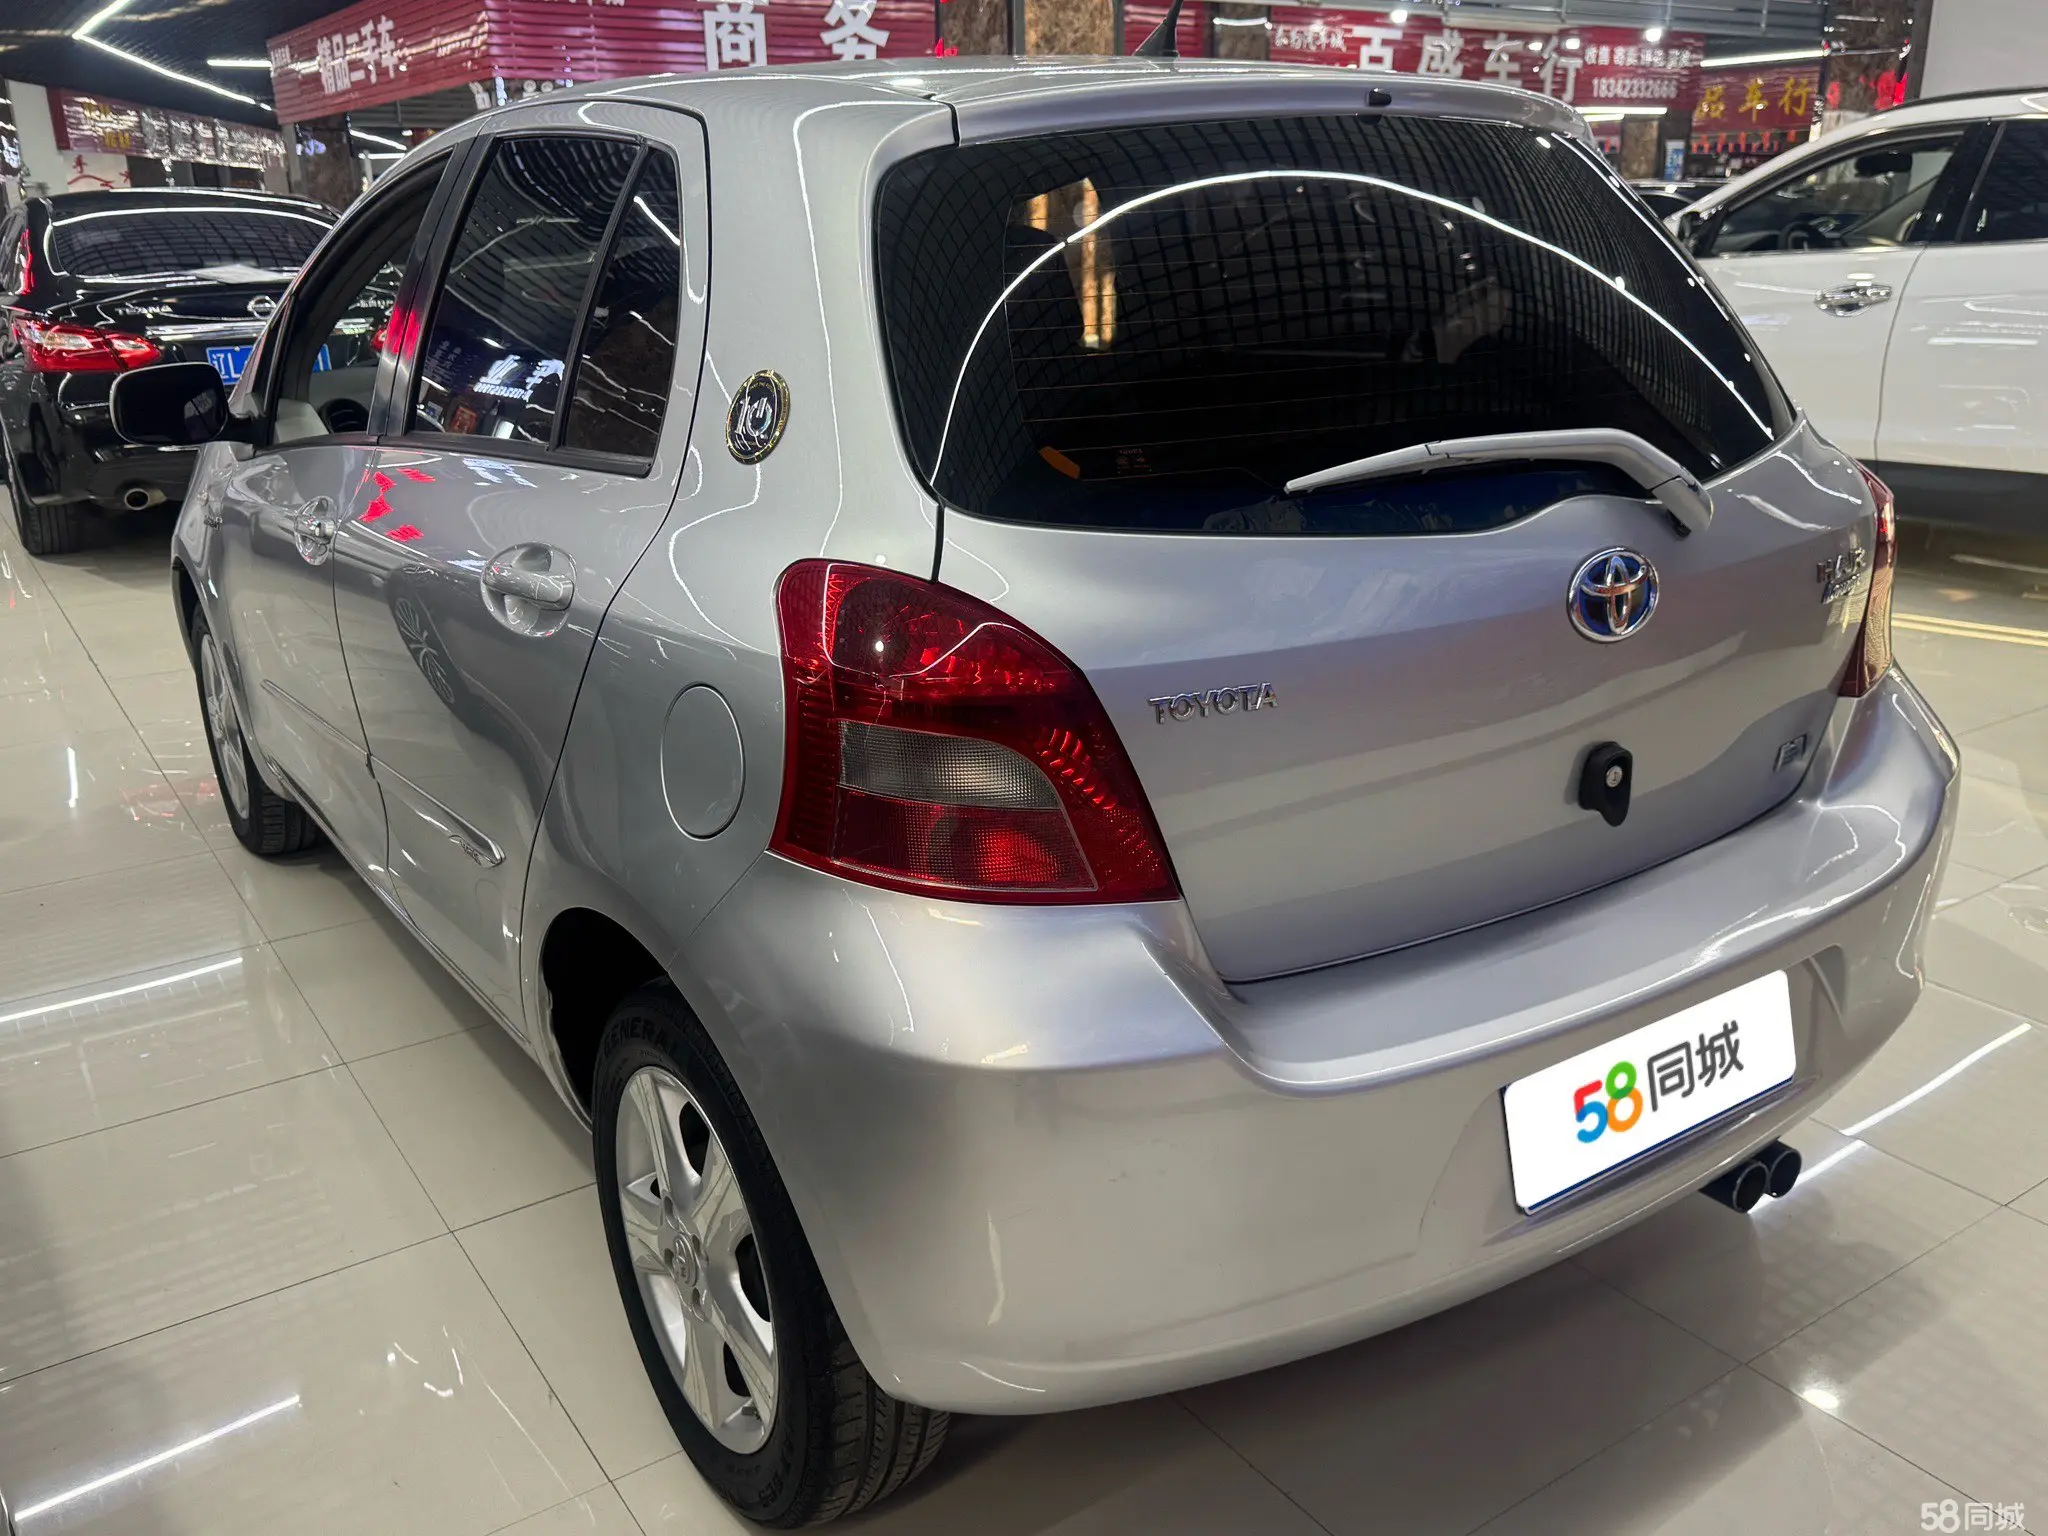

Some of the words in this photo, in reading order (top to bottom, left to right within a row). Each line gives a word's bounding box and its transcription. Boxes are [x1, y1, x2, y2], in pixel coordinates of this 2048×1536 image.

[316, 14, 399, 95] 精品二手车
[1147, 682, 1278, 724] TOYOTA
